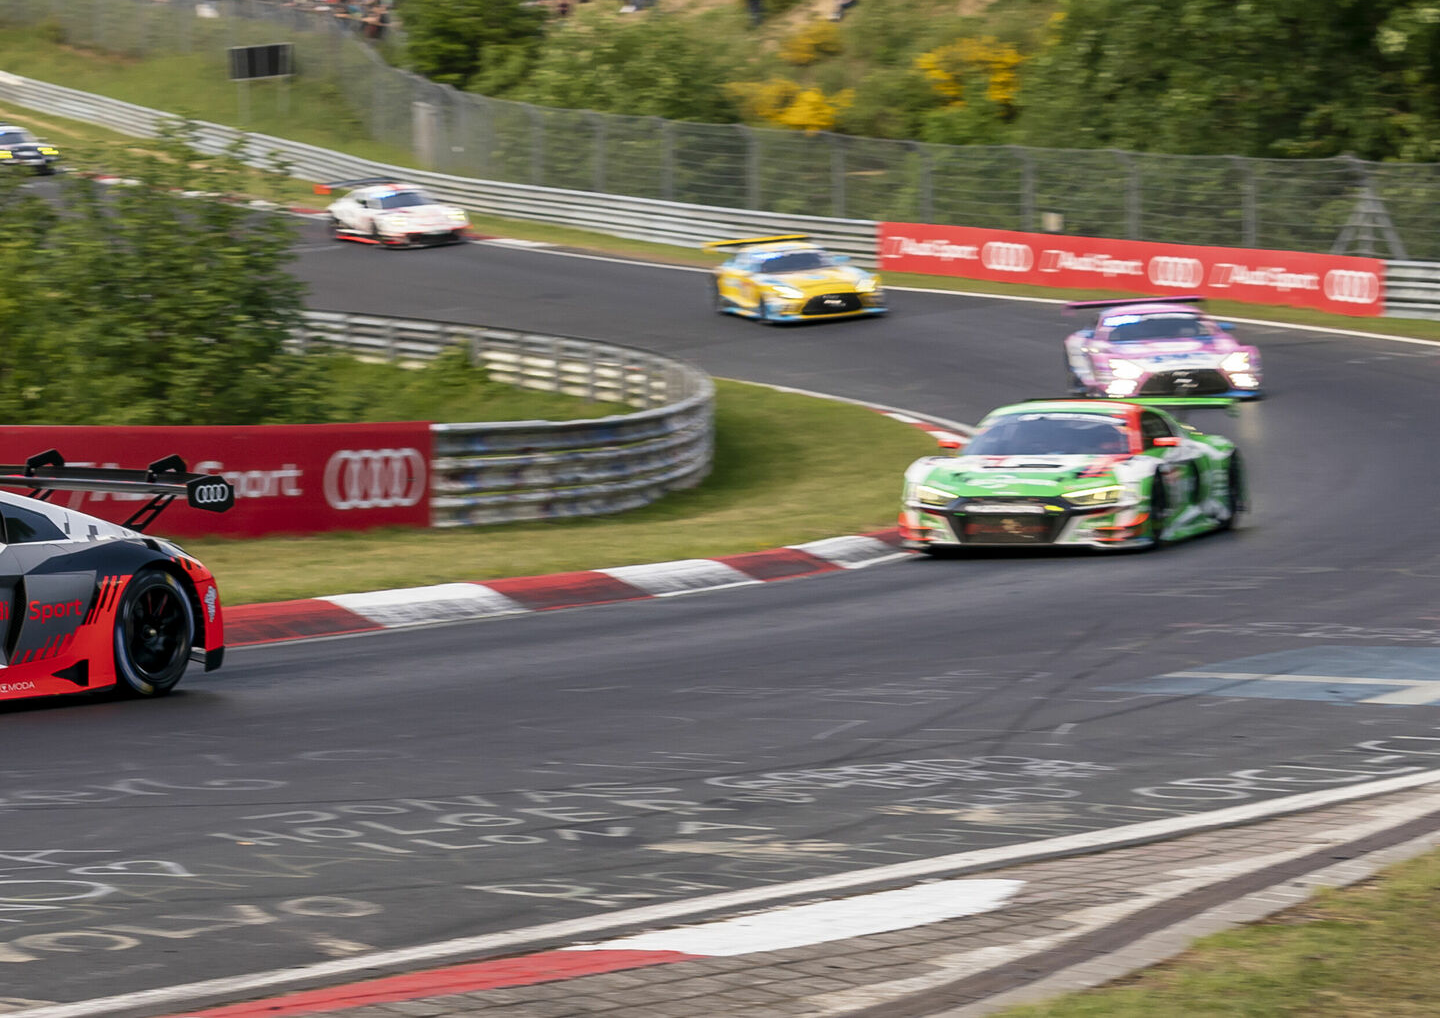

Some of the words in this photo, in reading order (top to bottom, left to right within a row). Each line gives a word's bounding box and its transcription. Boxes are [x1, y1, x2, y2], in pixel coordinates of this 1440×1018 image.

[29, 599, 83, 624] Sport
[208, 798, 739, 847] HOLGER
[239, 781, 680, 824] JONAS
